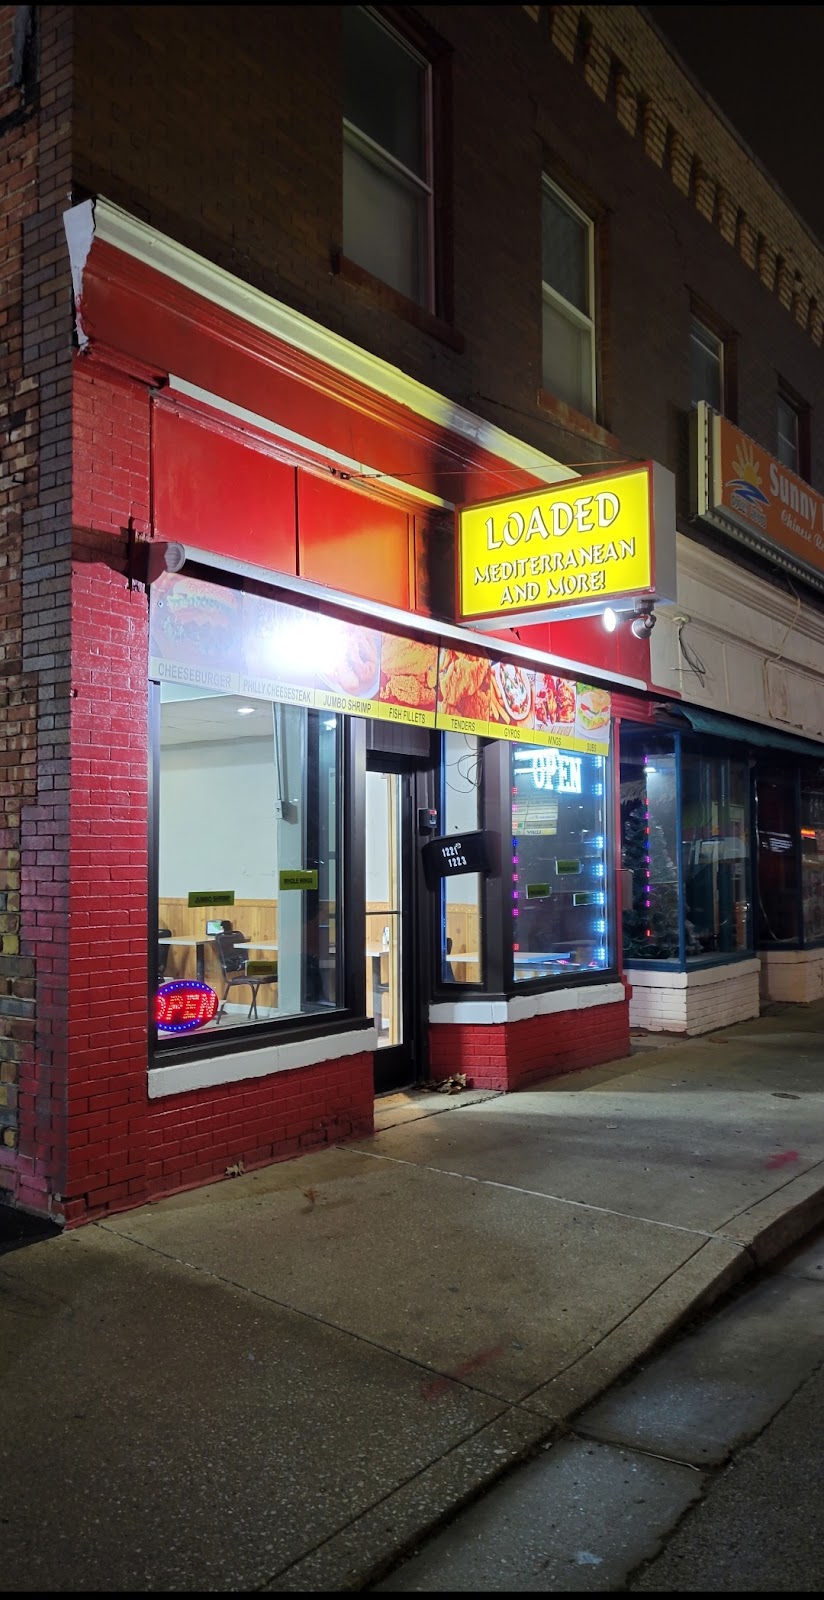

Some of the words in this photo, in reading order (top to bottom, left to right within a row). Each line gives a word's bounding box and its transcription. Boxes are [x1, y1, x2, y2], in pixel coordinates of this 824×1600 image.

[769, 462, 817, 530] Sunny
[484, 491, 621, 551] LOADED
[781, 509, 812, 543] Chinese
[473, 537, 636, 586] MEDITERRANEAN
[500, 582, 541, 606] AND
[546, 570, 607, 598] MORE!
[158, 662, 232, 688] CHEESEBURGER
[243, 679, 266, 695] PHILLY
[267, 682, 312, 703] CHEESESTEAK
[322, 694, 347, 710] JUMBO
[347, 699, 372, 714] SHRIMP
[388, 707, 402, 720] FISH
[403, 710, 426, 724] FILLETS
[451, 718, 476, 732] TENDERS
[503, 727, 521, 740] GYROS
[530, 755, 582, 794] OPEN
[448, 856, 467, 868] 1223
